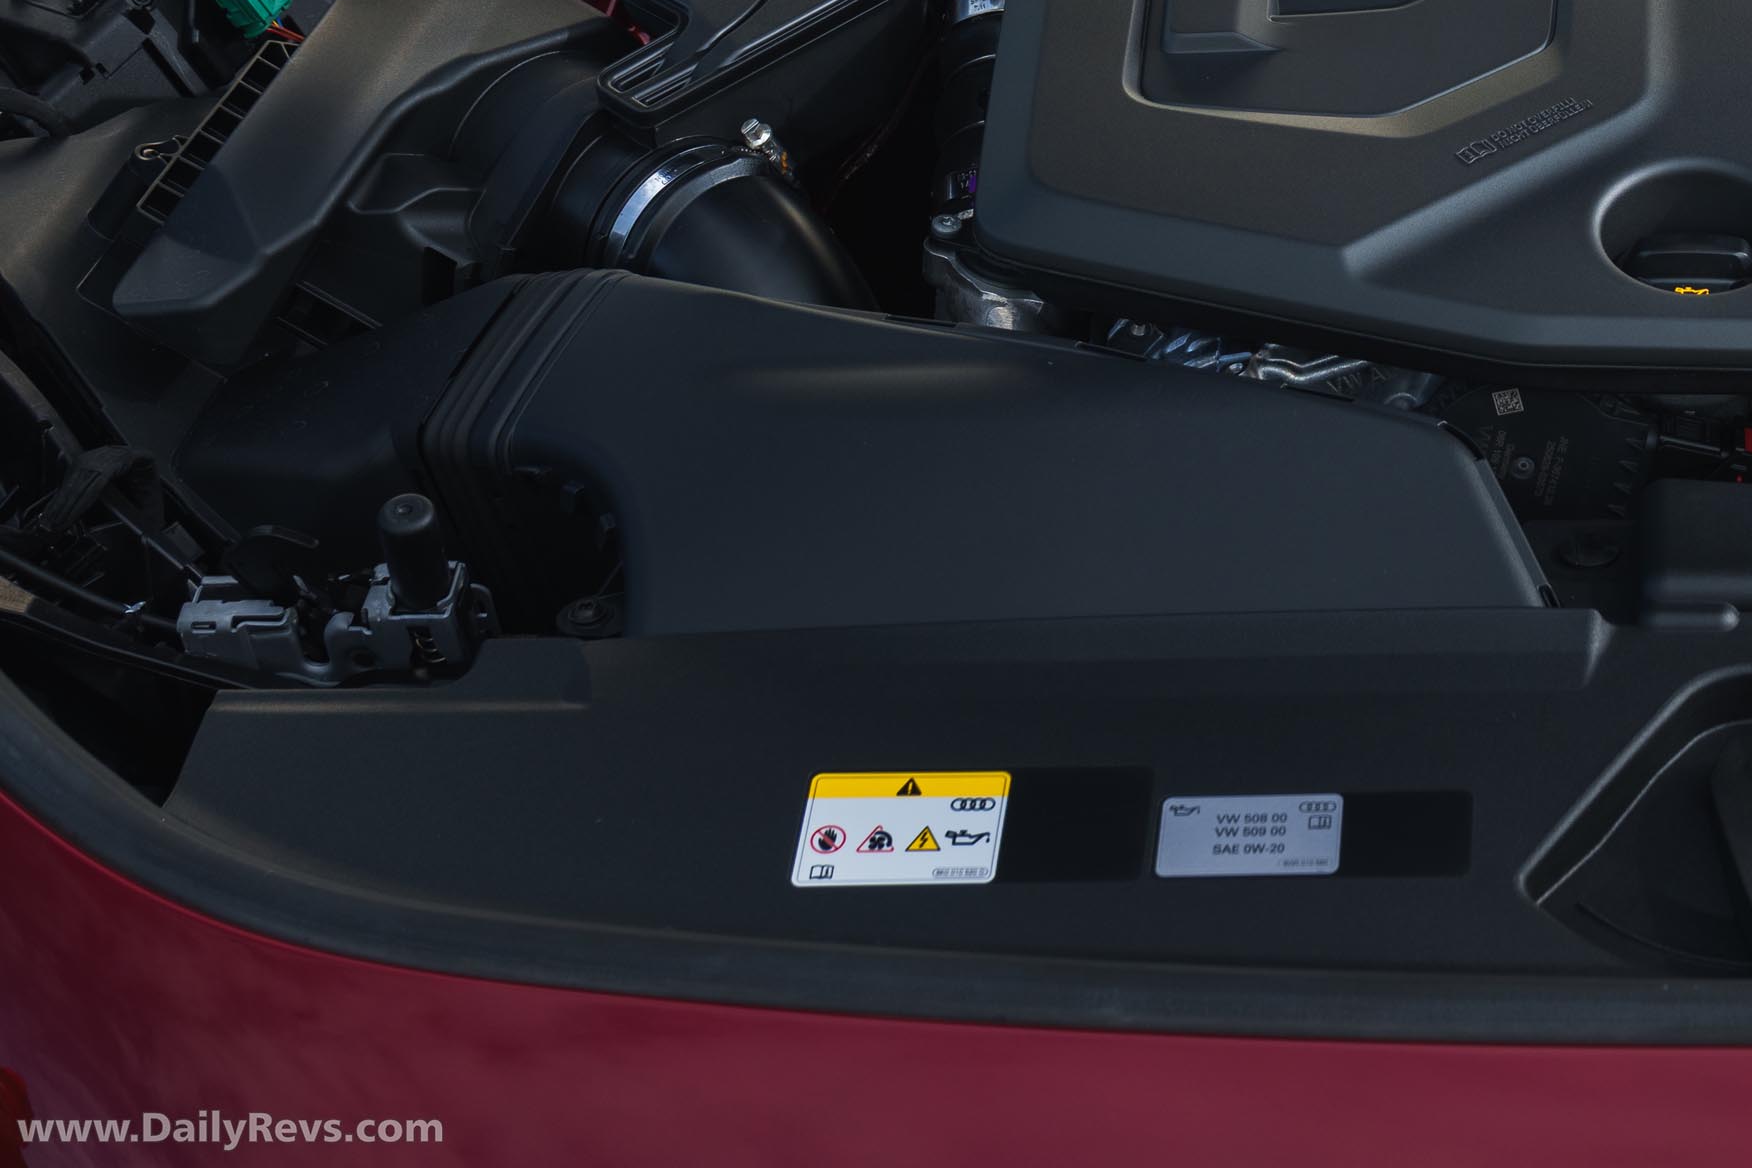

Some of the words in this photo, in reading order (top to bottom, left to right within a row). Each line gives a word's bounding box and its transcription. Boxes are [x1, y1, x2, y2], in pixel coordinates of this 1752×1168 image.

[1217, 813, 1240, 824] VW
[1244, 813, 1268, 824] 508
[1271, 813, 1288, 823] 00
[1215, 826, 1239, 837] VW
[1243, 826, 1267, 837] 509
[1270, 826, 1287, 836] 00
[1212, 844, 1239, 855] SAE
[1243, 843, 1285, 854] 0W-20
